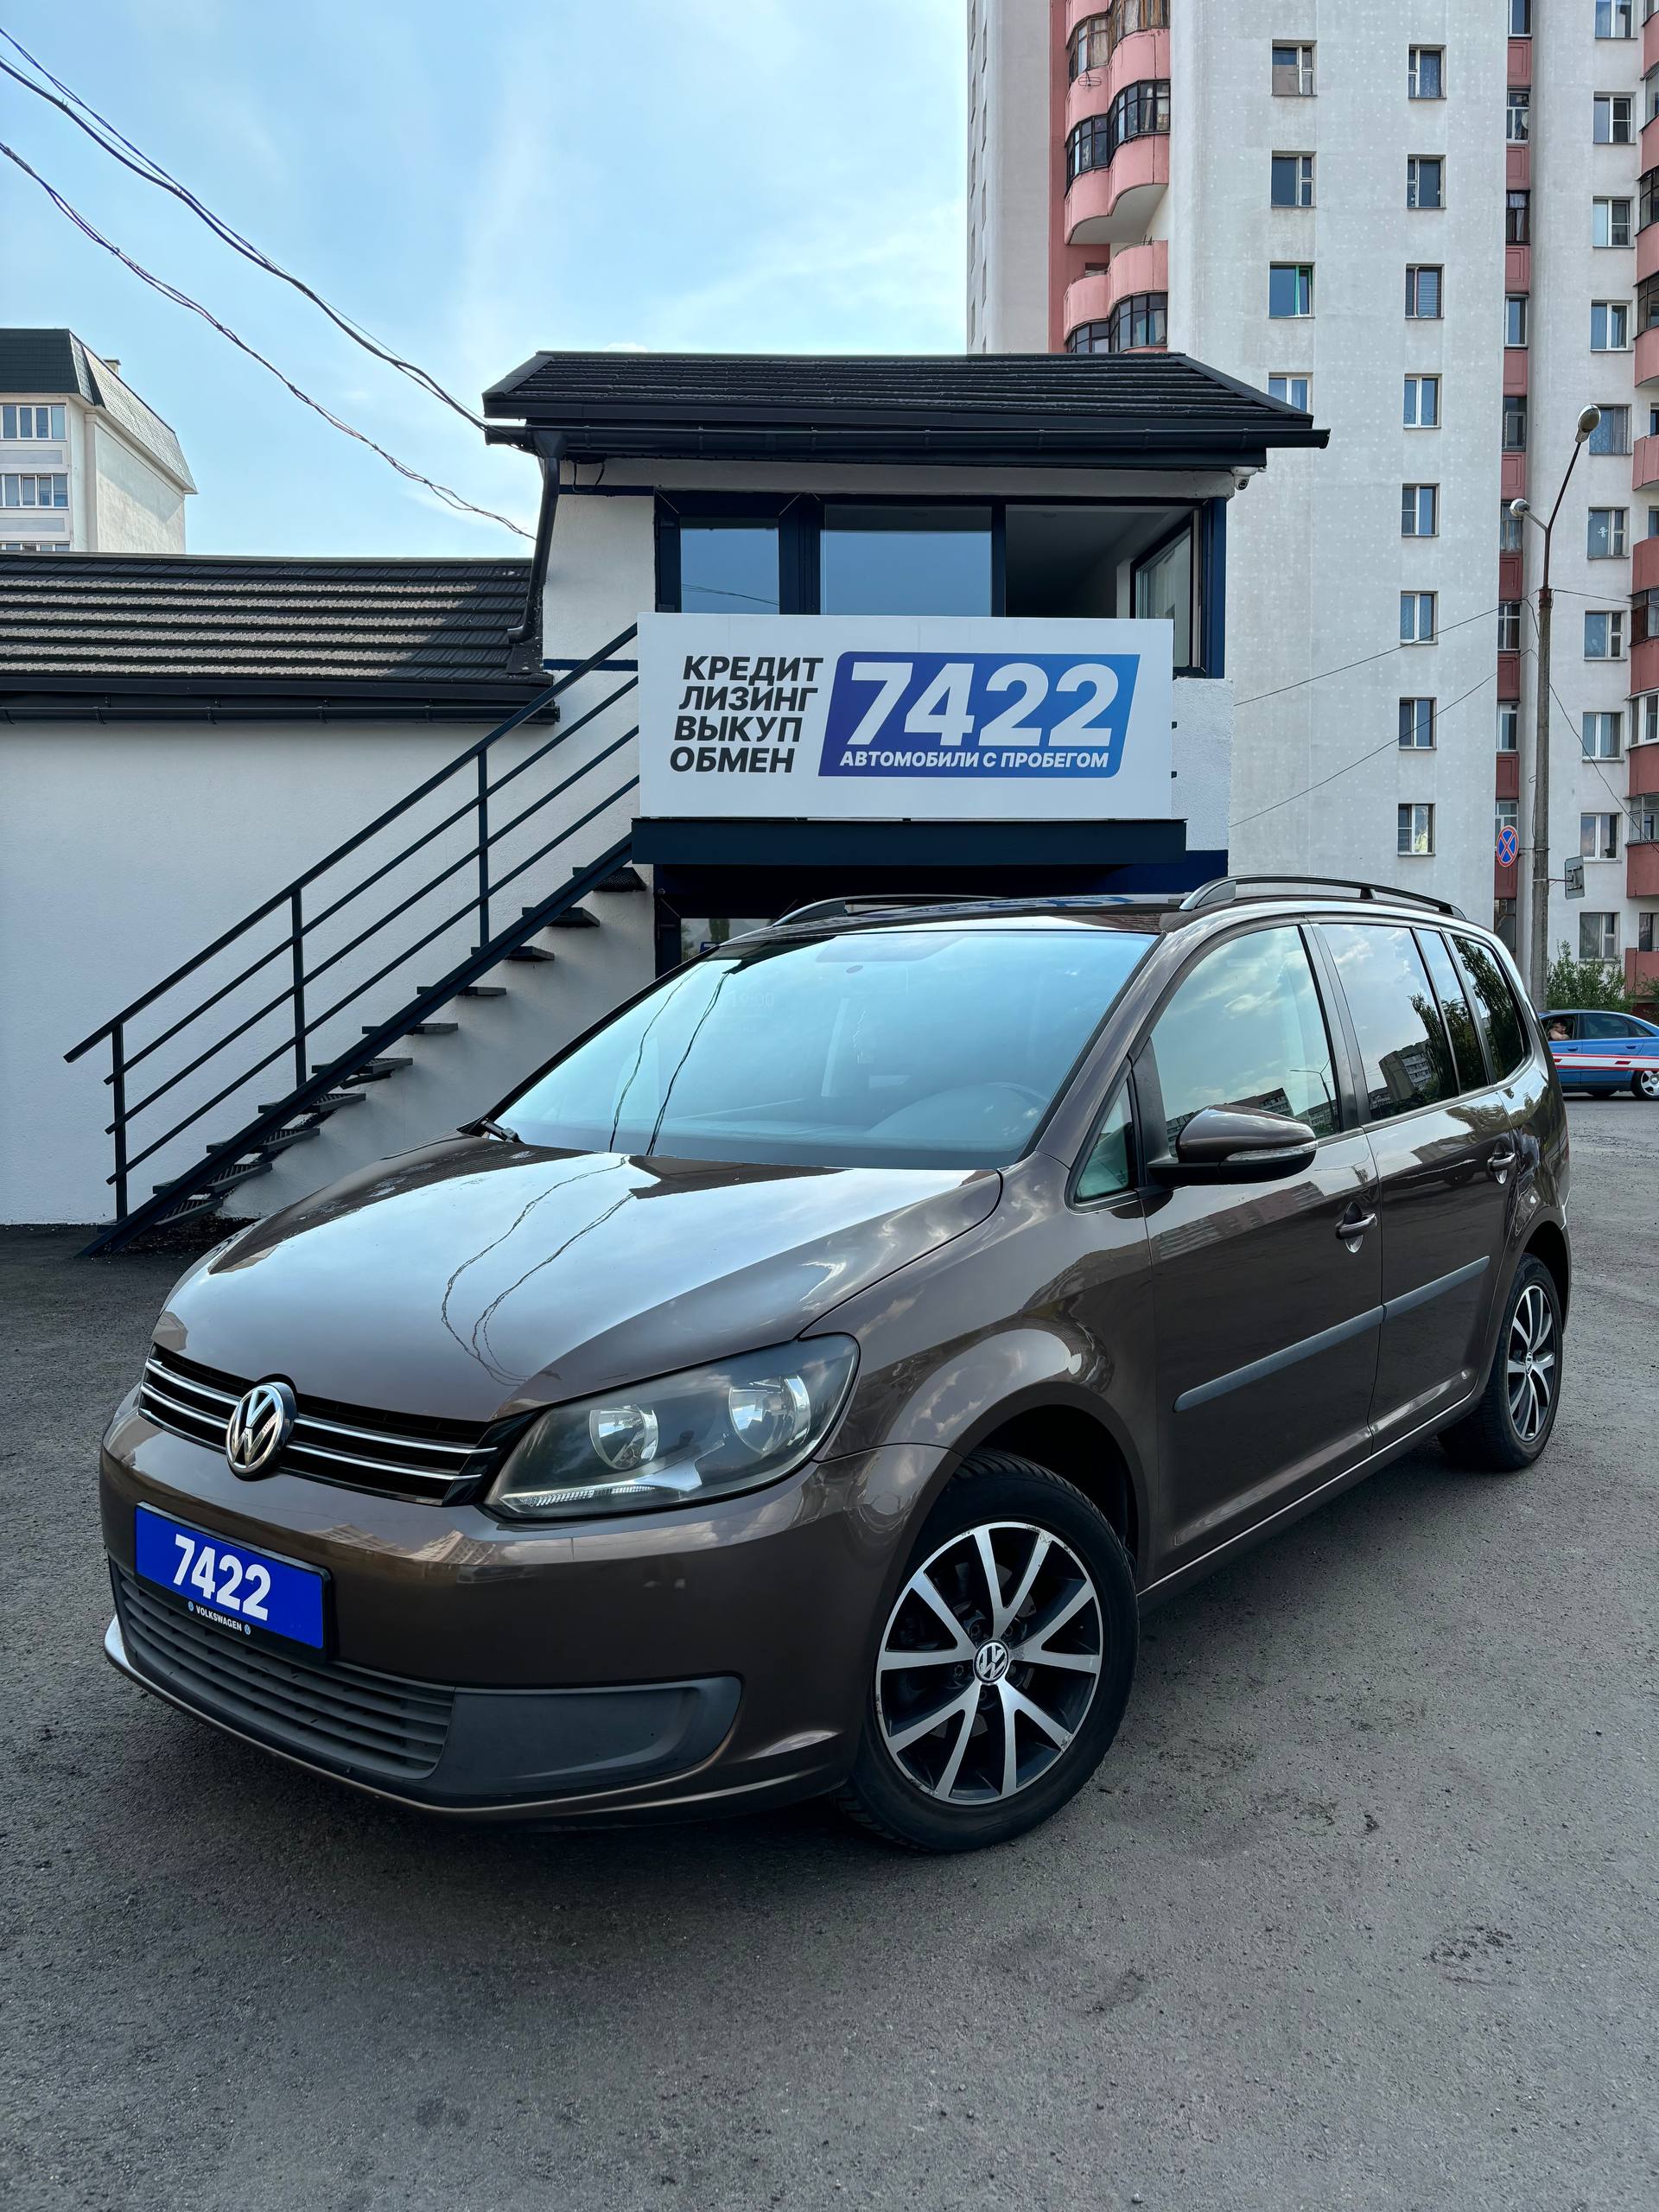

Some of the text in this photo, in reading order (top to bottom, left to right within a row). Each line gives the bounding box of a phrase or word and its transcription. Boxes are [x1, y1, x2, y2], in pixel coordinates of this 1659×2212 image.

[683, 655, 823, 685] КРЕДИТ
[678, 685, 818, 711] ЛИЗИНГ
[846, 661, 1119, 746] 7422
[674, 715, 803, 742] ВЫКУП
[670, 747, 795, 772] ОБМЕН
[839, 750, 1109, 768] АВТОМОБИЛИ С ПРОБЕГОМ
[173, 1534, 271, 1621] 7422
[195, 1605, 242, 1631] VOLKSWAGEN
